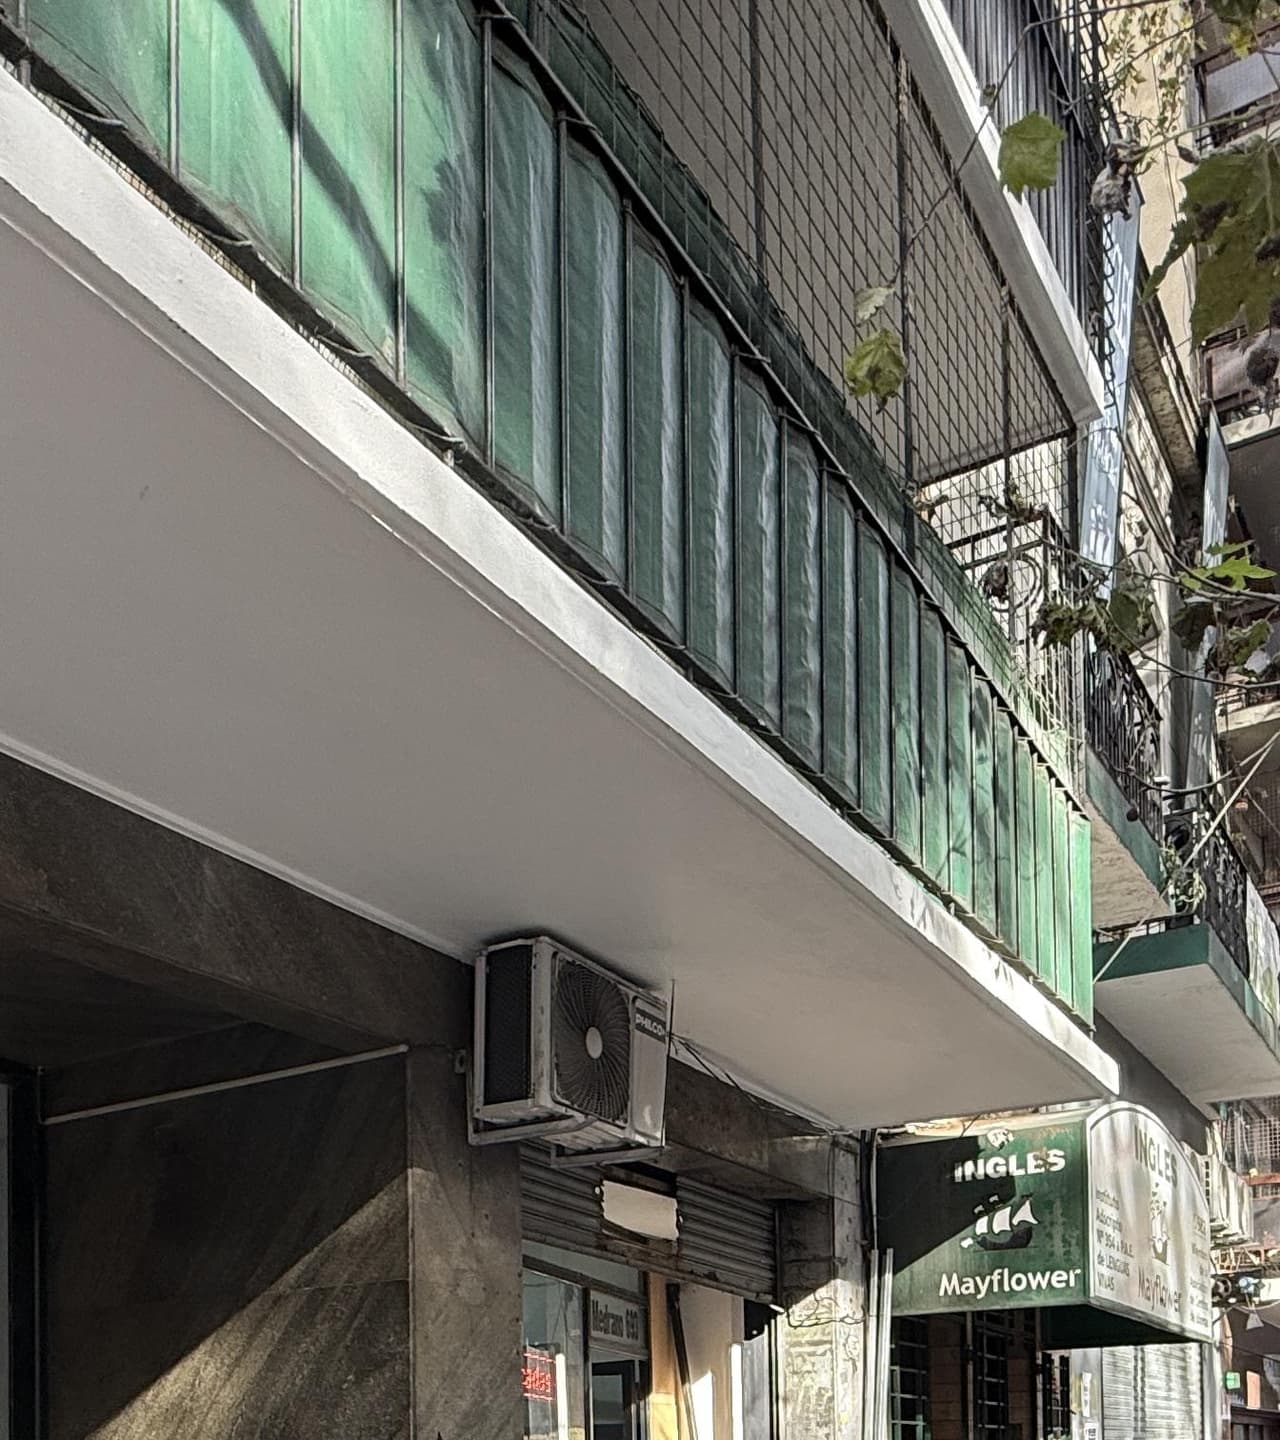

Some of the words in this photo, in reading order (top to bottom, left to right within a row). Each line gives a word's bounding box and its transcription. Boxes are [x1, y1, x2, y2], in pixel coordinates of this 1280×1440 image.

[635, 1013, 663, 1036] PHILCO
[954, 1149, 1066, 1182] INGLES
[1134, 1124, 1178, 1188] INGLES
[939, 1268, 1081, 1299] Mayflower
[1138, 1265, 1182, 1312] Mayflower
[591, 1299, 624, 1337] Medrano
